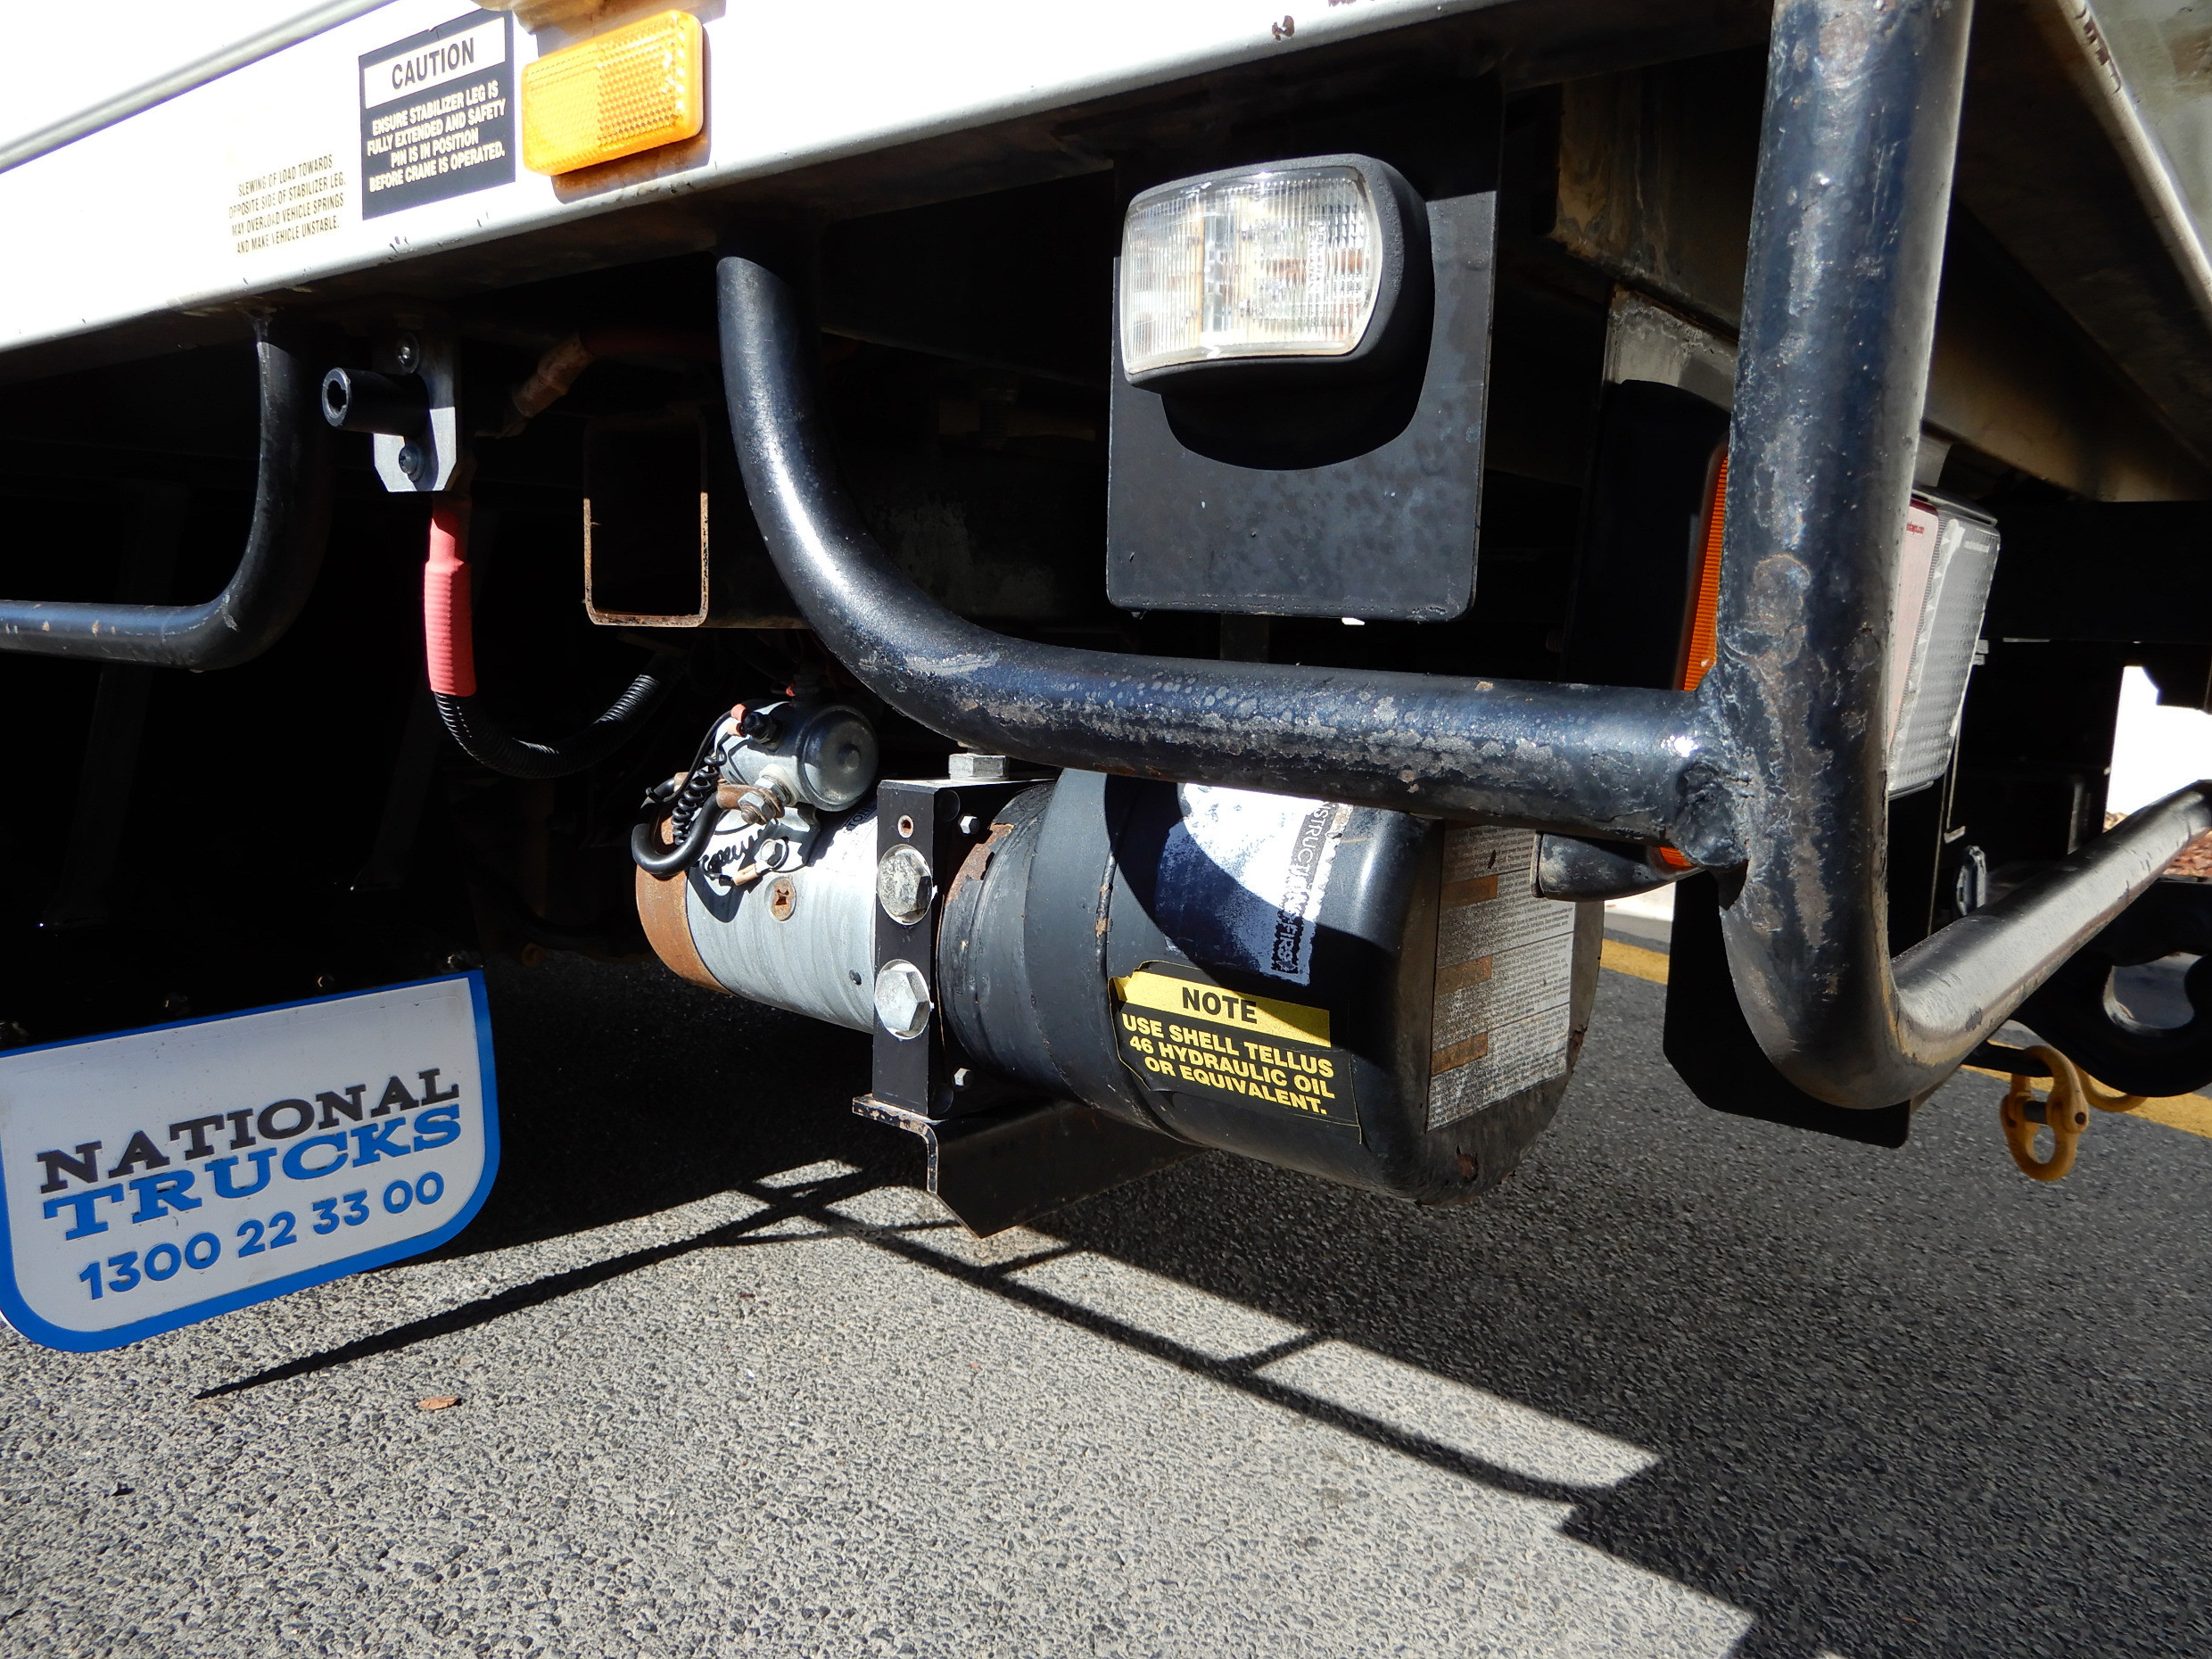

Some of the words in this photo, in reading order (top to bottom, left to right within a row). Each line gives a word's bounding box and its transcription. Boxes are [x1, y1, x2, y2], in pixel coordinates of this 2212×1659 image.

[392, 37, 475, 90] CAUTION
[367, 134, 393, 156] FULLY
[394, 119, 443, 147] EXTENDED
[445, 111, 466, 133] AND
[467, 98, 506, 126] SAFETY
[372, 110, 409, 136] ENSURE
[409, 92, 465, 125] STABILIZER
[466, 85, 485, 105] LEG
[487, 80, 499, 99] IS
[238, 176, 266, 197] SLEWING
[268, 172, 276, 187] OF
[279, 166, 296, 184] LOAD
[299, 153, 333, 177] TOWARDS
[369, 169, 403, 193] BEFORE
[405, 160, 437, 182] CRANE
[438, 156, 449, 173] IS
[450, 141, 506, 169] OPERATED.
[391, 152, 407, 168] PIN
[409, 147, 418, 163] IS
[420, 142, 431, 160] IN
[433, 128, 479, 156] POSITION
[229, 198, 259, 219] OPPOSITE
[261, 193, 276, 210] SIDE
[278, 189, 286, 204] OF
[289, 177, 327, 201] STABILIZER
[331, 171, 346, 189] LEG.
[232, 222, 244, 236] MAY
[246, 211, 280, 234] OVERLOAD
[282, 202, 310, 223] VEHICLE
[313, 192, 344, 214] SPRINGS
[237, 240, 249, 253] AND
[252, 234, 269, 251] MAKE
[271, 226, 299, 244] VEHICLE
[301, 215, 340, 237] UNSTABLE.
[1182, 986, 1258, 1024] NOTE
[1121, 1013, 1165, 1039] USE
[1169, 1024, 1240, 1057] SHELL
[1243, 1041, 1334, 1078] TELLUS
[1129, 1035, 1154, 1054] 46
[1158, 1041, 1288, 1086] HYDRAULIC
[1293, 1074, 1335, 1099] OIL
[1144, 1056, 1176, 1077] OR
[1180, 1065, 1327, 1115] EQUIVALENT.
[37, 1068, 459, 1193] NATIONAL
[43, 1103, 461, 1241] TRUCKS
[78, 1232, 221, 1300] 1300
[236, 1211, 297, 1258] 22
[312, 1189, 370, 1235] 33
[384, 1171, 444, 1214] 00
